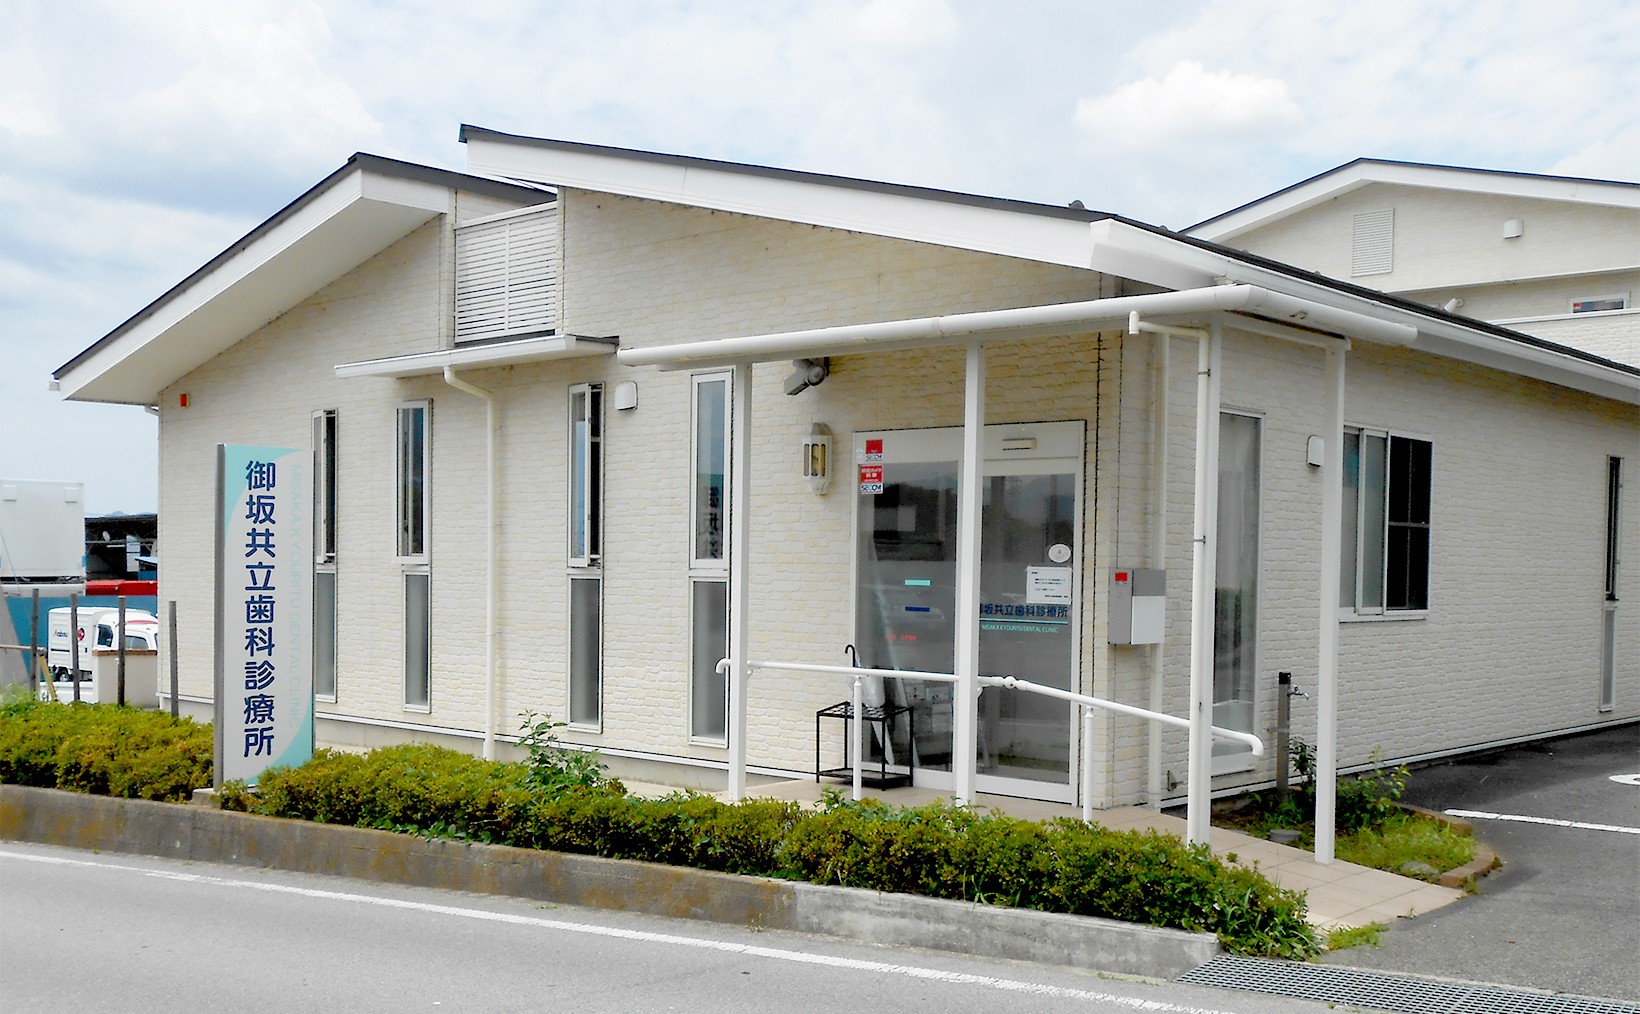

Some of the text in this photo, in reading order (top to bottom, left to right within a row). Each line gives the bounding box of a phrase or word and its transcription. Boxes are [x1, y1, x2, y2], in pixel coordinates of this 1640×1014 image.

[290, 464, 302, 524] MISAKA
[243, 459, 277, 758] 御坂共立歯科診療所
[290, 613, 301, 673] DENTAL
[289, 676, 301, 728] CLINIC
